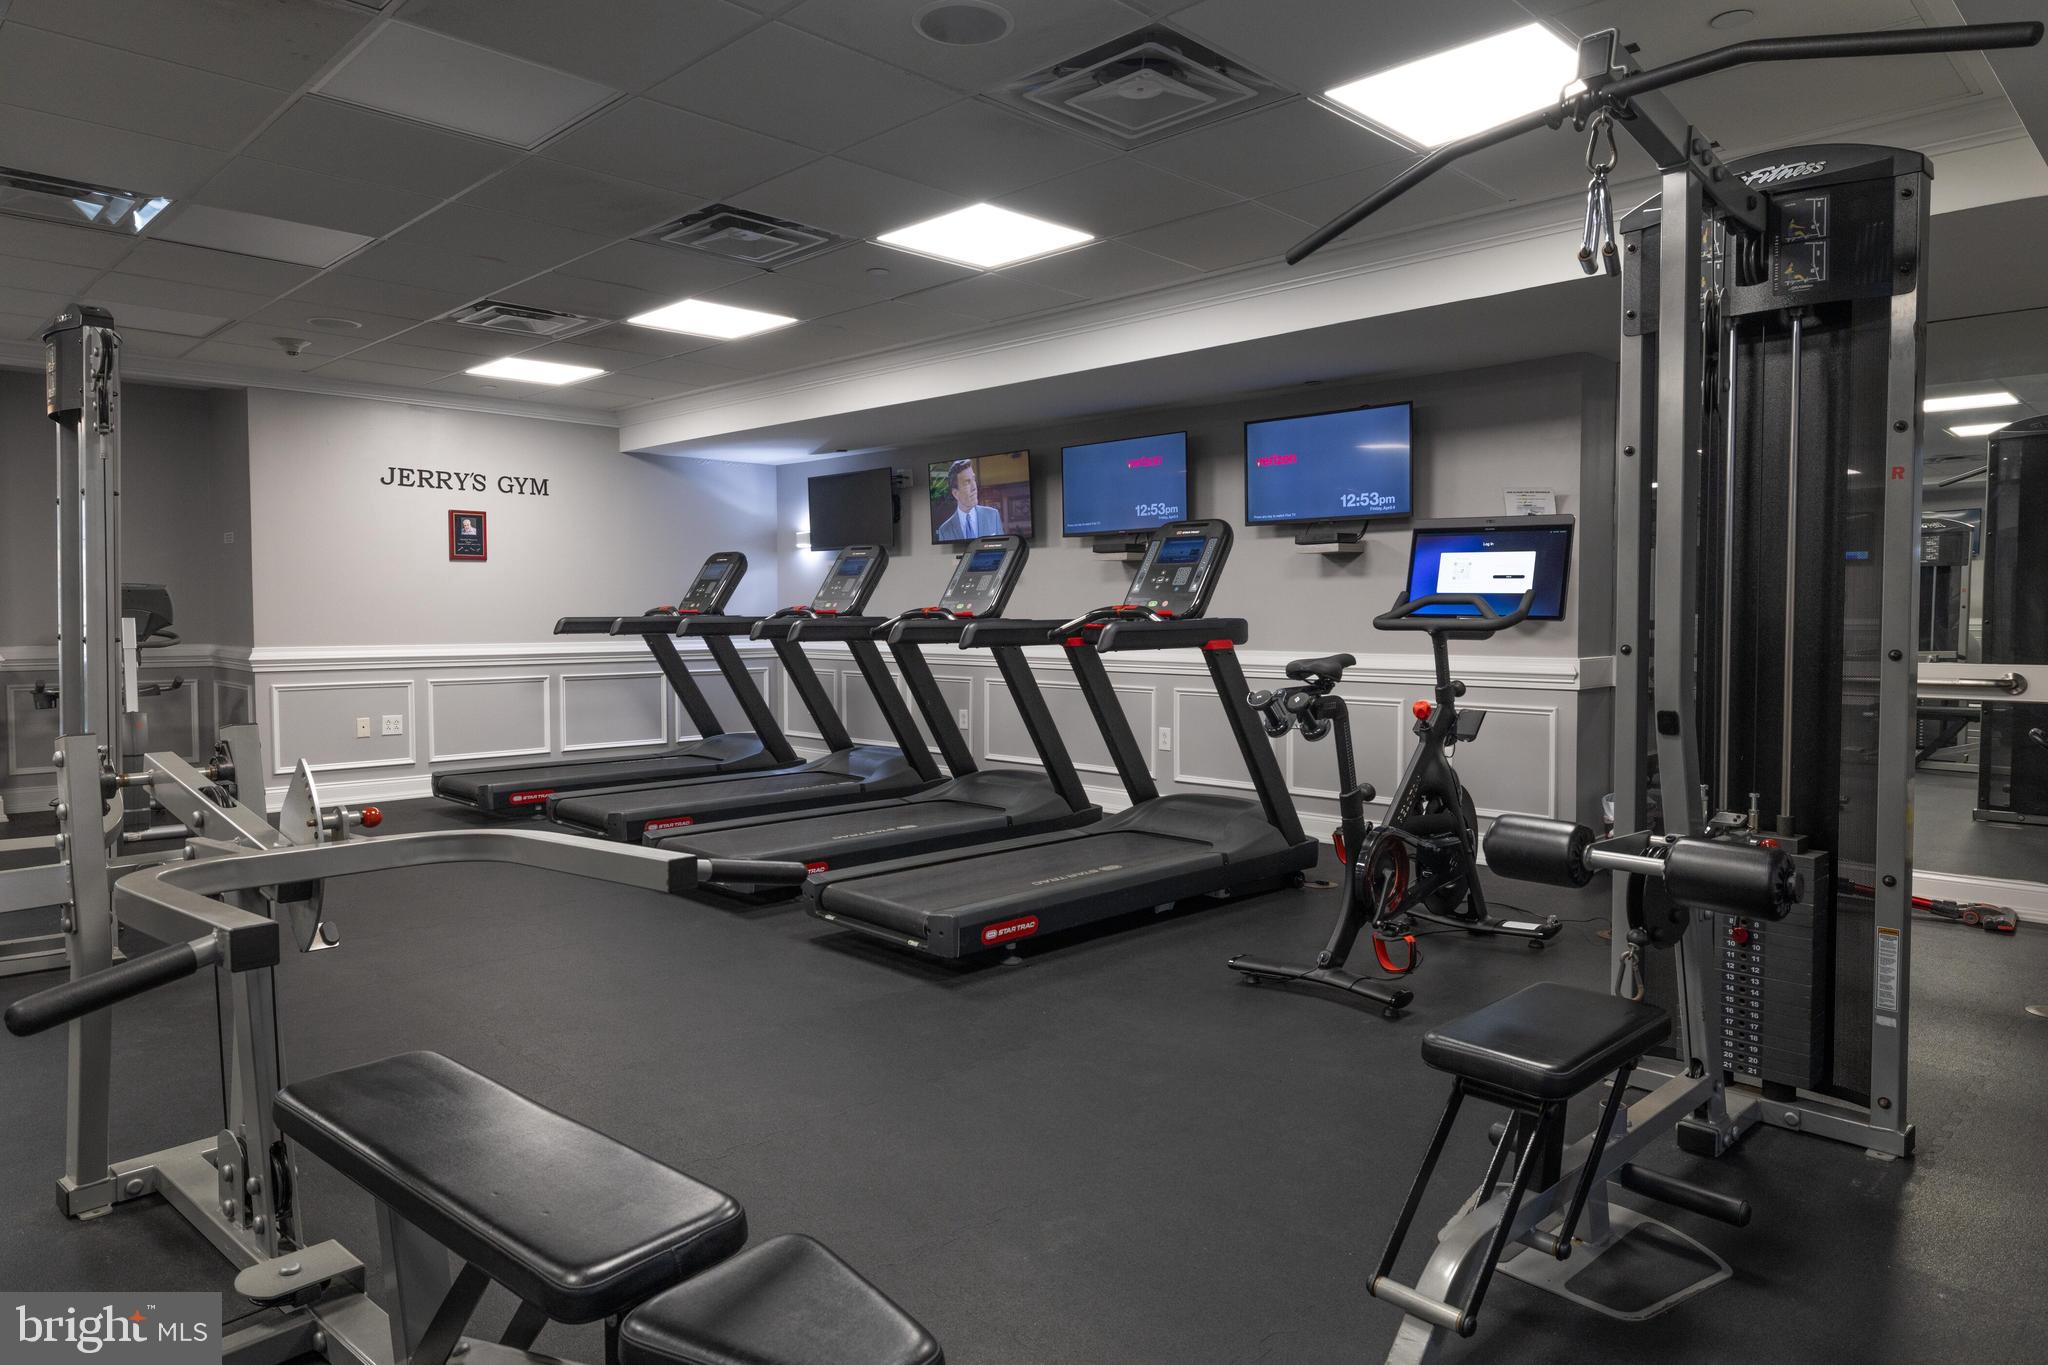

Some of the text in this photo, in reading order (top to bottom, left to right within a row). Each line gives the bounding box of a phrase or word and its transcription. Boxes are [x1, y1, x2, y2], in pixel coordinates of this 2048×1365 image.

[1746, 160, 1827, 186] Fitness
[1891, 466, 1904, 480] R
[380, 466, 550, 496] JERRY'S GYM
[1340, 492, 1396, 508] 12:53pm
[1135, 502, 1179, 517] 12:53pm
[998, 921, 1035, 936] STAR TRAC
